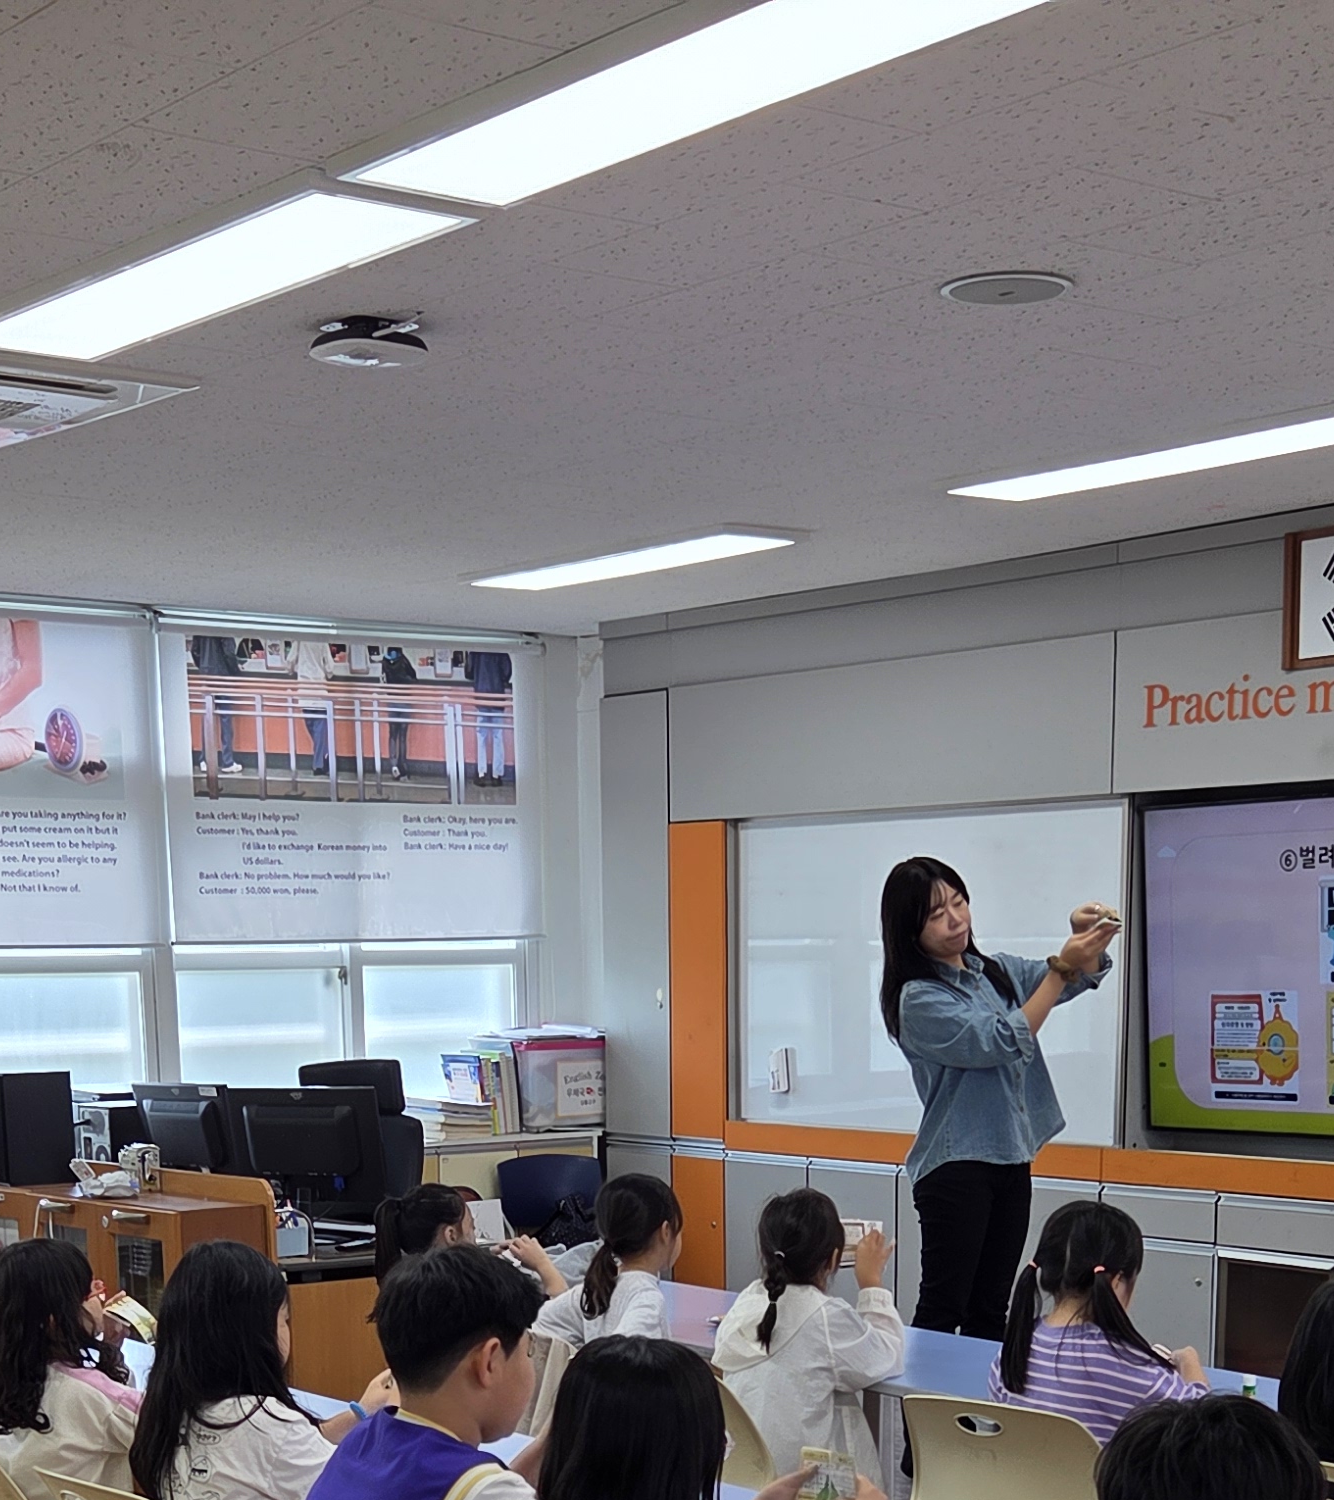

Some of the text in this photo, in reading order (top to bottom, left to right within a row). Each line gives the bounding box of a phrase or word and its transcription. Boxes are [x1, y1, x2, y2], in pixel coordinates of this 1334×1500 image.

[1142, 674, 1295, 729] Practice
[11, 810, 28, 819] you
[30, 810, 58, 820] taking
[61, 810, 100, 822] anything
[102, 812, 114, 820] for
[117, 812, 126, 820] it?
[2, 825, 17, 834] put
[44, 826, 72, 834] cream
[86, 826, 93, 834] it
[95, 826, 110, 834] but
[112, 826, 118, 834] it
[69, 840, 79, 848] be
[81, 840, 117, 851] helping.
[22, 855, 35, 863] Are
[38, 857, 54, 865] you
[57, 855, 88, 865] allergic
[90, 856, 100, 864] to
[102, 857, 117, 866] any
[1, 869, 59, 878] medications?
[0, 883, 17, 892] Not
[19, 884, 35, 892] that
[43, 883, 67, 892] know
[70, 883, 81, 892] of.
